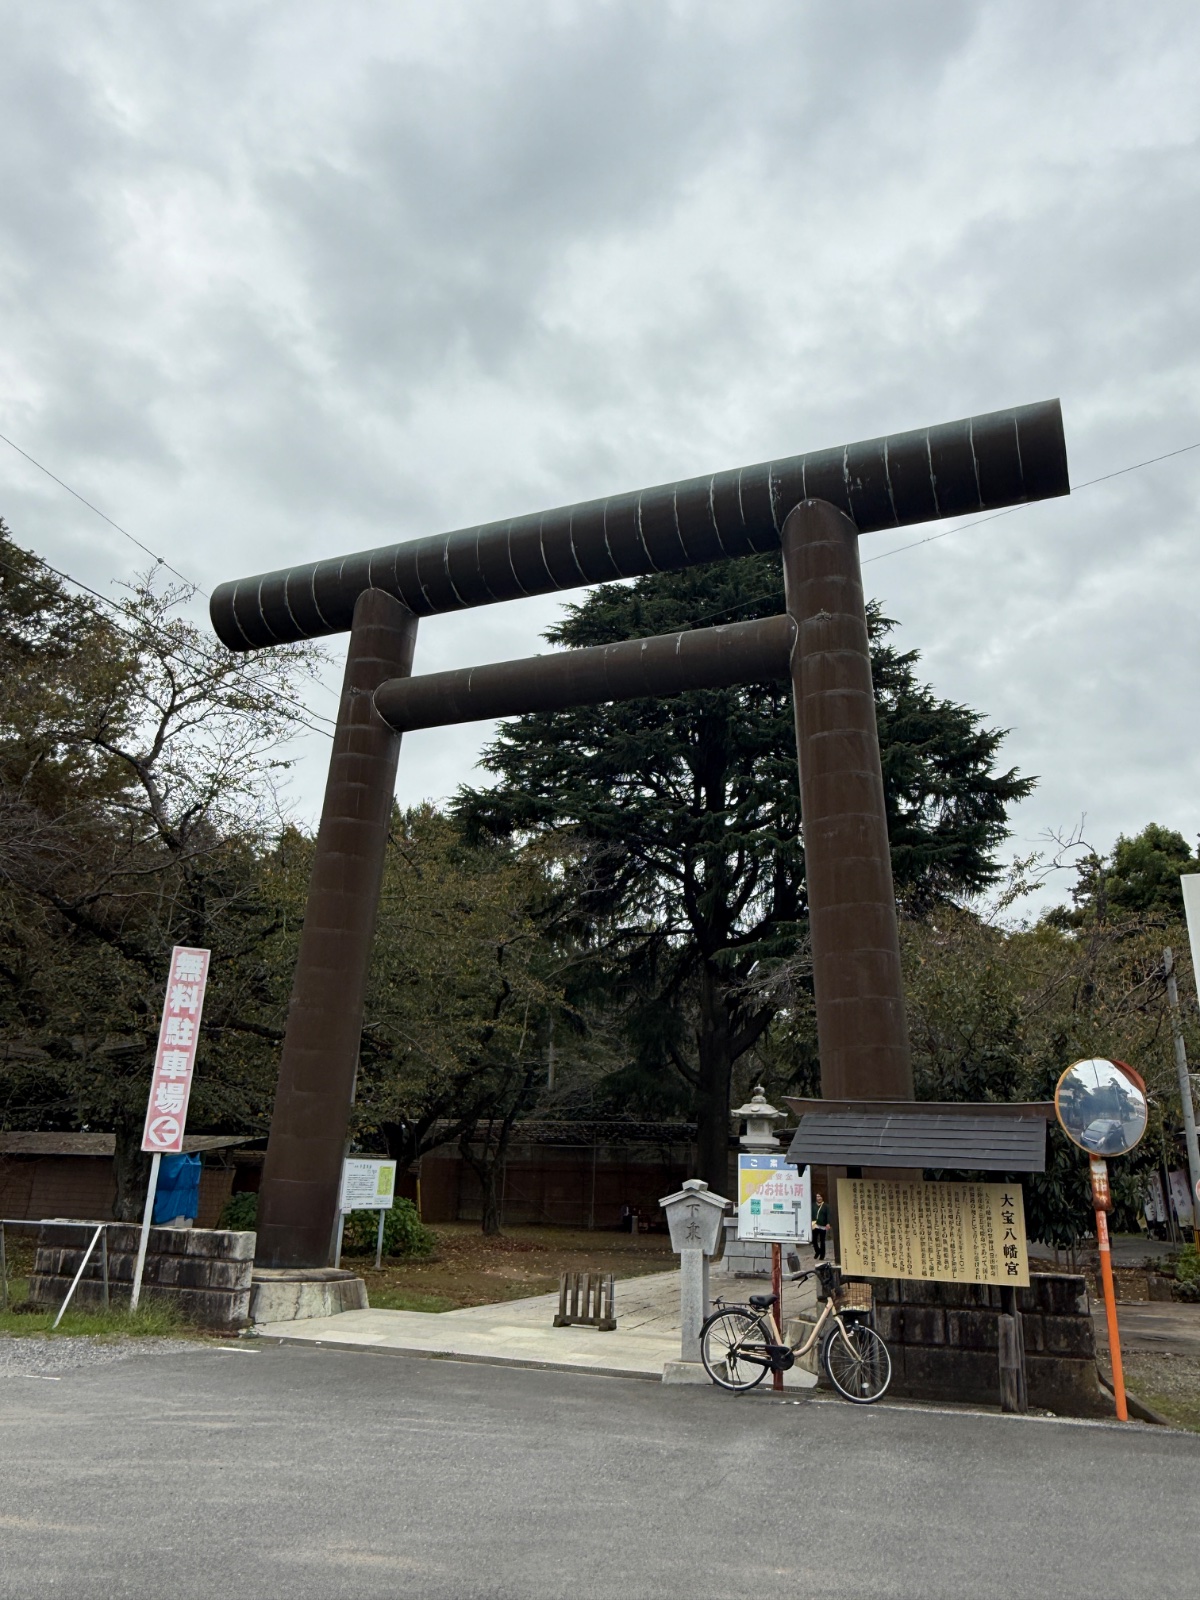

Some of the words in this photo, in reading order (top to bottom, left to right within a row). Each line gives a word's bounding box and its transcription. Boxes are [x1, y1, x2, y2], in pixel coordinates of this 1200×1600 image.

[155, 952, 204, 1114] 無料駐車場
[1000, 1193, 1019, 1276] 大宝八幡宮
